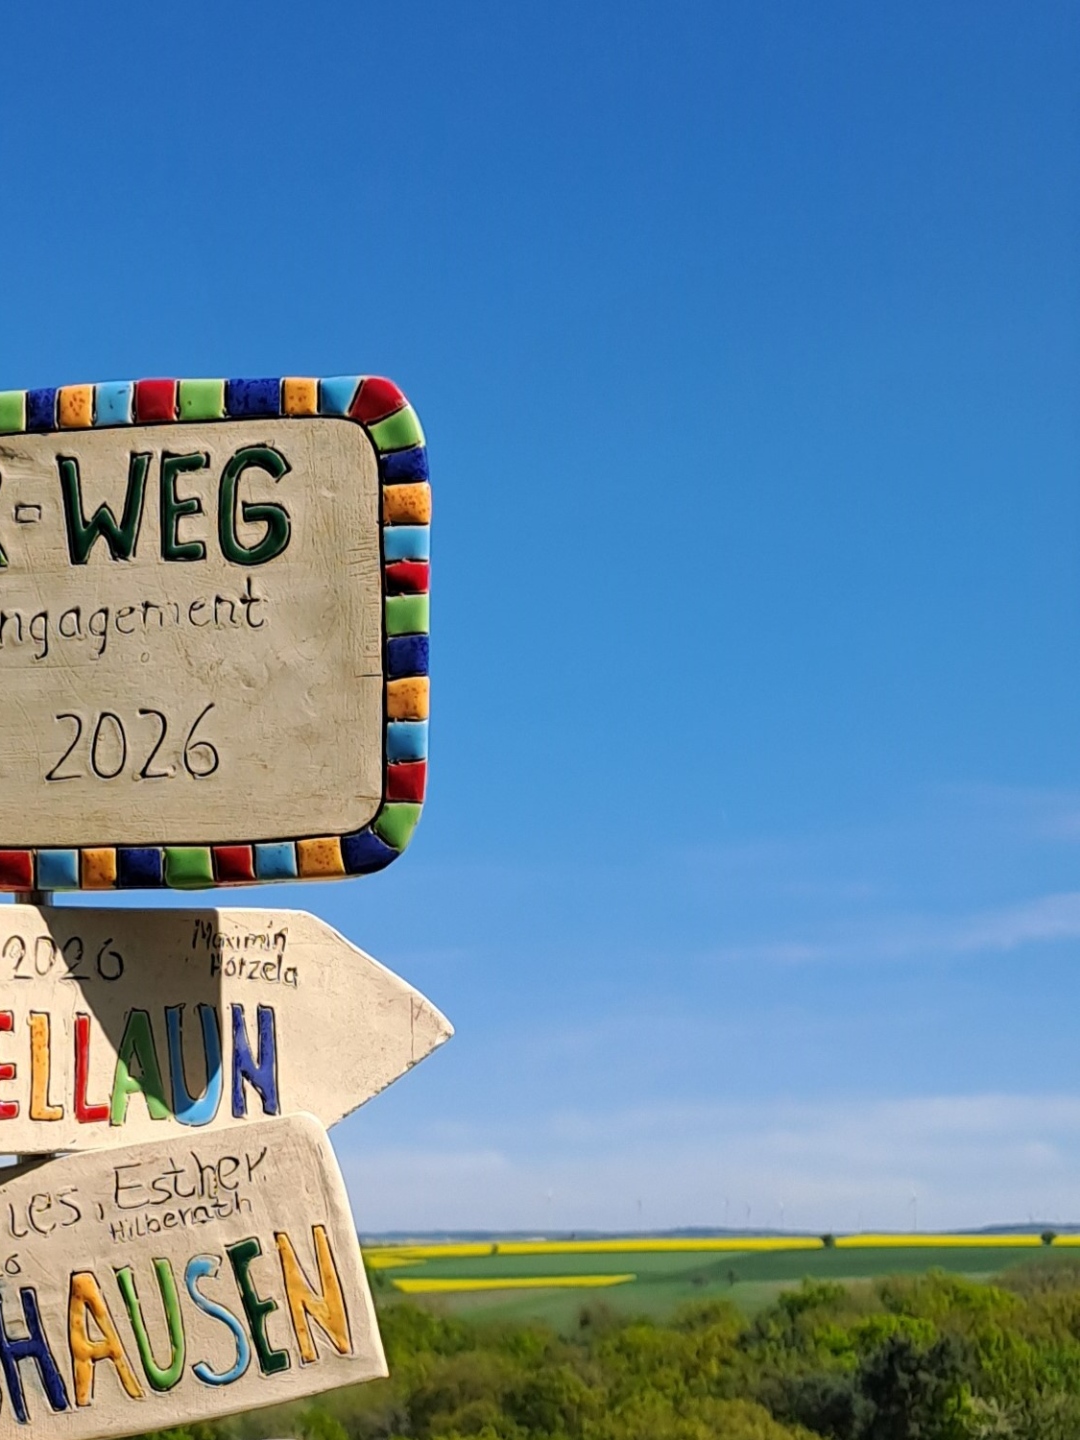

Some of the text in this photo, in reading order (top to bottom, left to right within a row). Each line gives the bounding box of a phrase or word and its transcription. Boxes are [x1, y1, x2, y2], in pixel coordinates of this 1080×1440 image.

[44, 702, 220, 782] 2026
[2, 935, 124, 981] 2026
[110, 1191, 252, 1243] Hilberath
